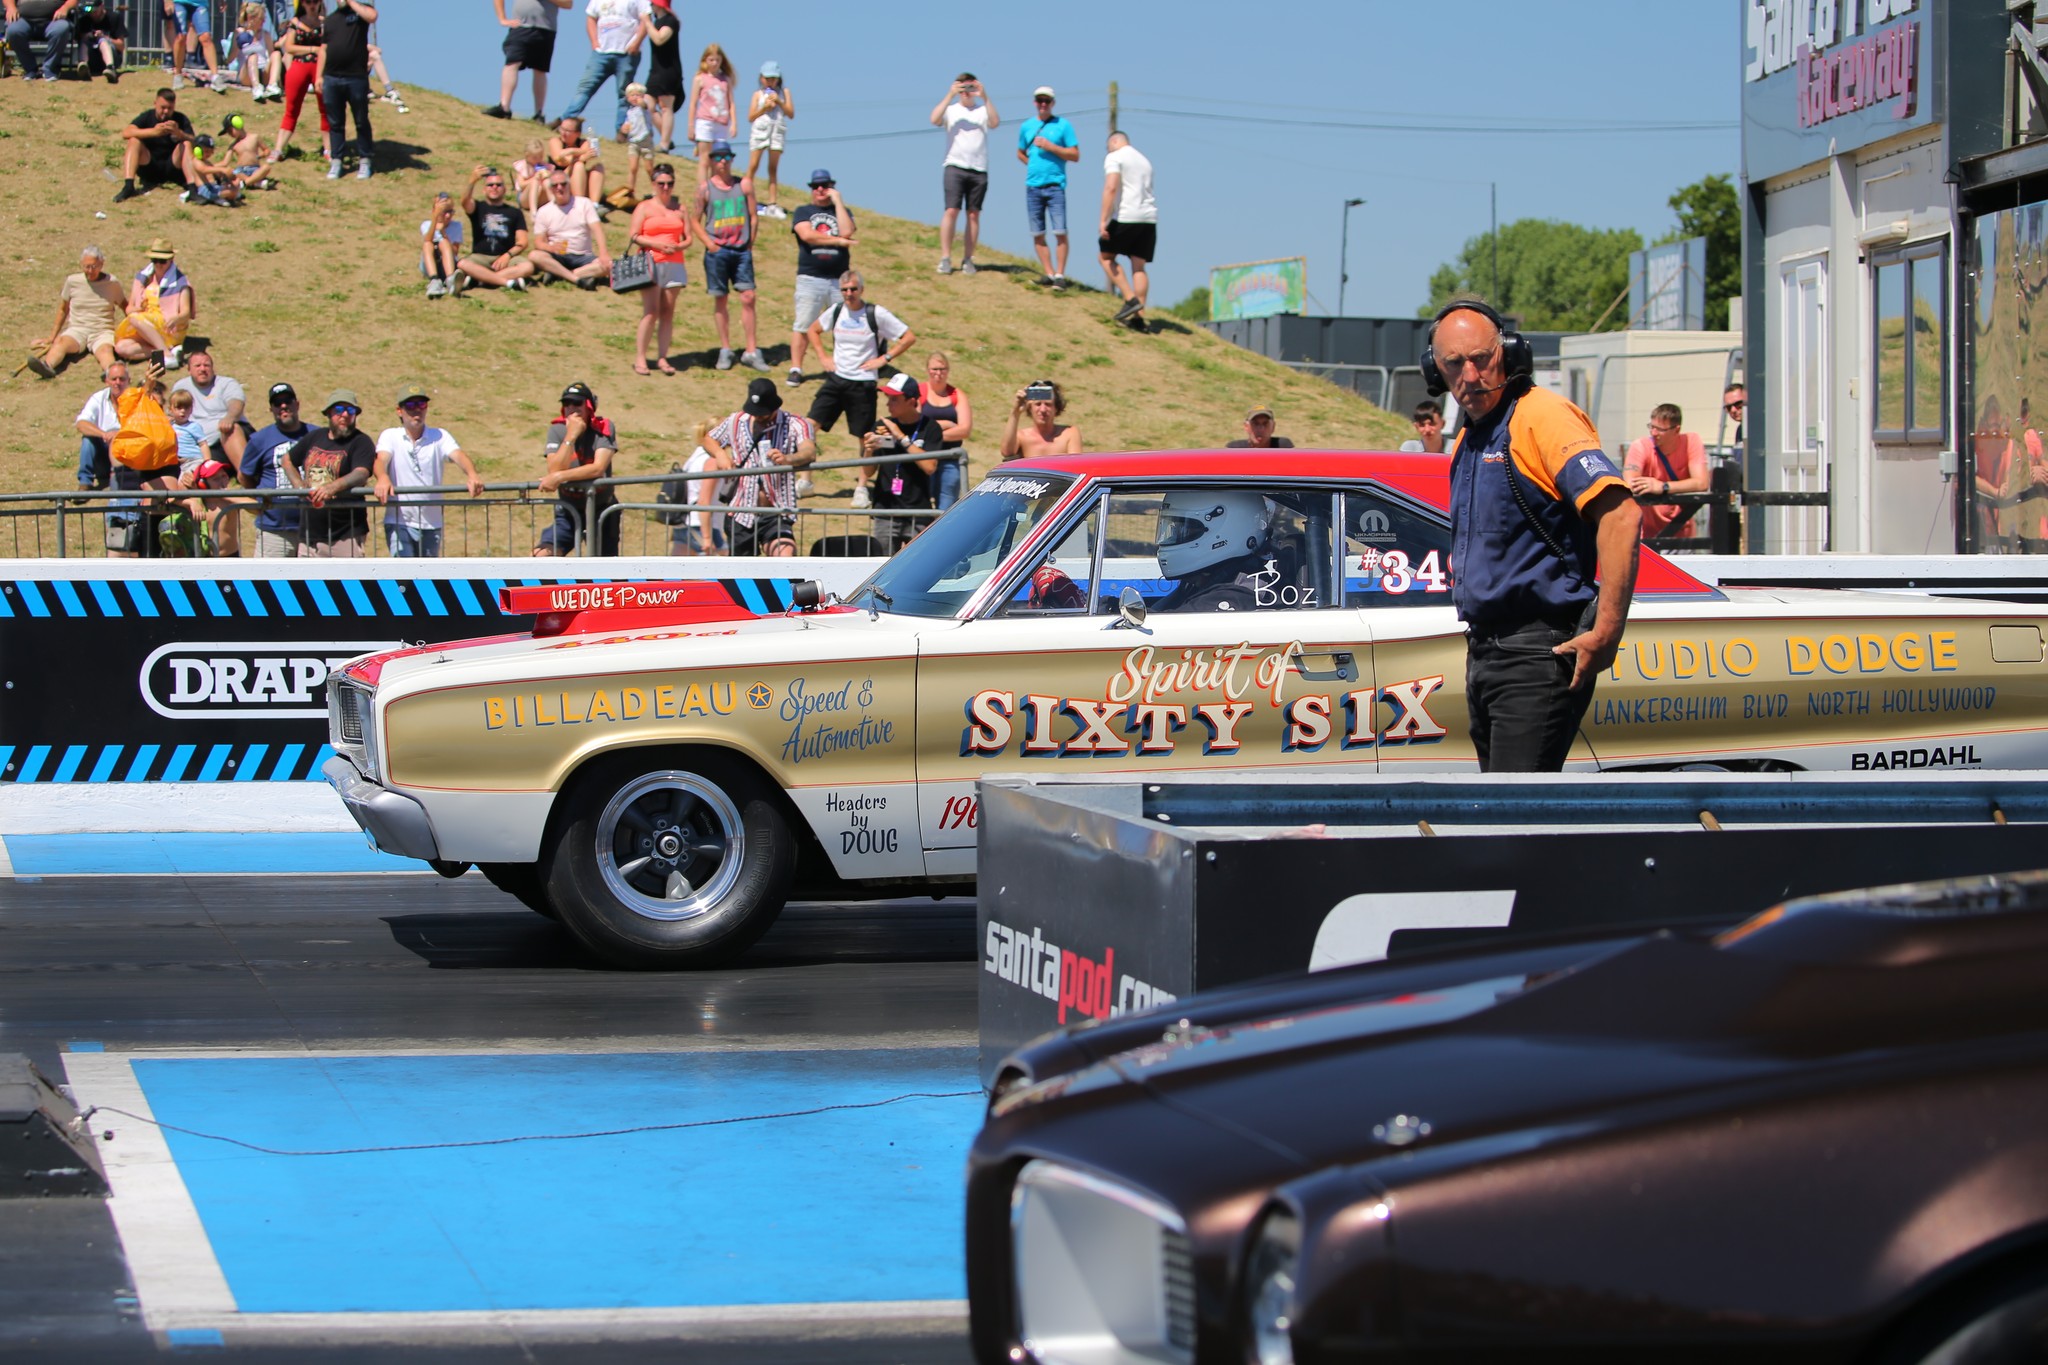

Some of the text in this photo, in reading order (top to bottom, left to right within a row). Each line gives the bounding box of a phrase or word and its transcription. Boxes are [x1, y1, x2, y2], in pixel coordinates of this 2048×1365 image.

[1797, 21, 1912, 128] Raceway
[1247, 569, 1317, 607] Boz
[1362, 548, 1454, 595] #34
[550, 586, 685, 613] WEDGE Power
[1106, 640, 1304, 707] Spirit of
[1785, 631, 1960, 676] DODGE
[169, 658, 331, 703] DRAP
[779, 674, 874, 725] Speed &
[484, 680, 741, 731] BILLADEAU
[959, 675, 1448, 759] SIXTY SIX
[1593, 696, 1728, 726] LANKERSHIM
[1807, 690, 1870, 717] NORTH
[1881, 686, 1997, 714] HOLLYWOOD
[781, 714, 895, 764] Automotive
[1852, 745, 1982, 770] BARDAHL
[826, 792, 887, 814] Headers
[850, 811, 869, 832] by
[840, 828, 898, 856] DOUG
